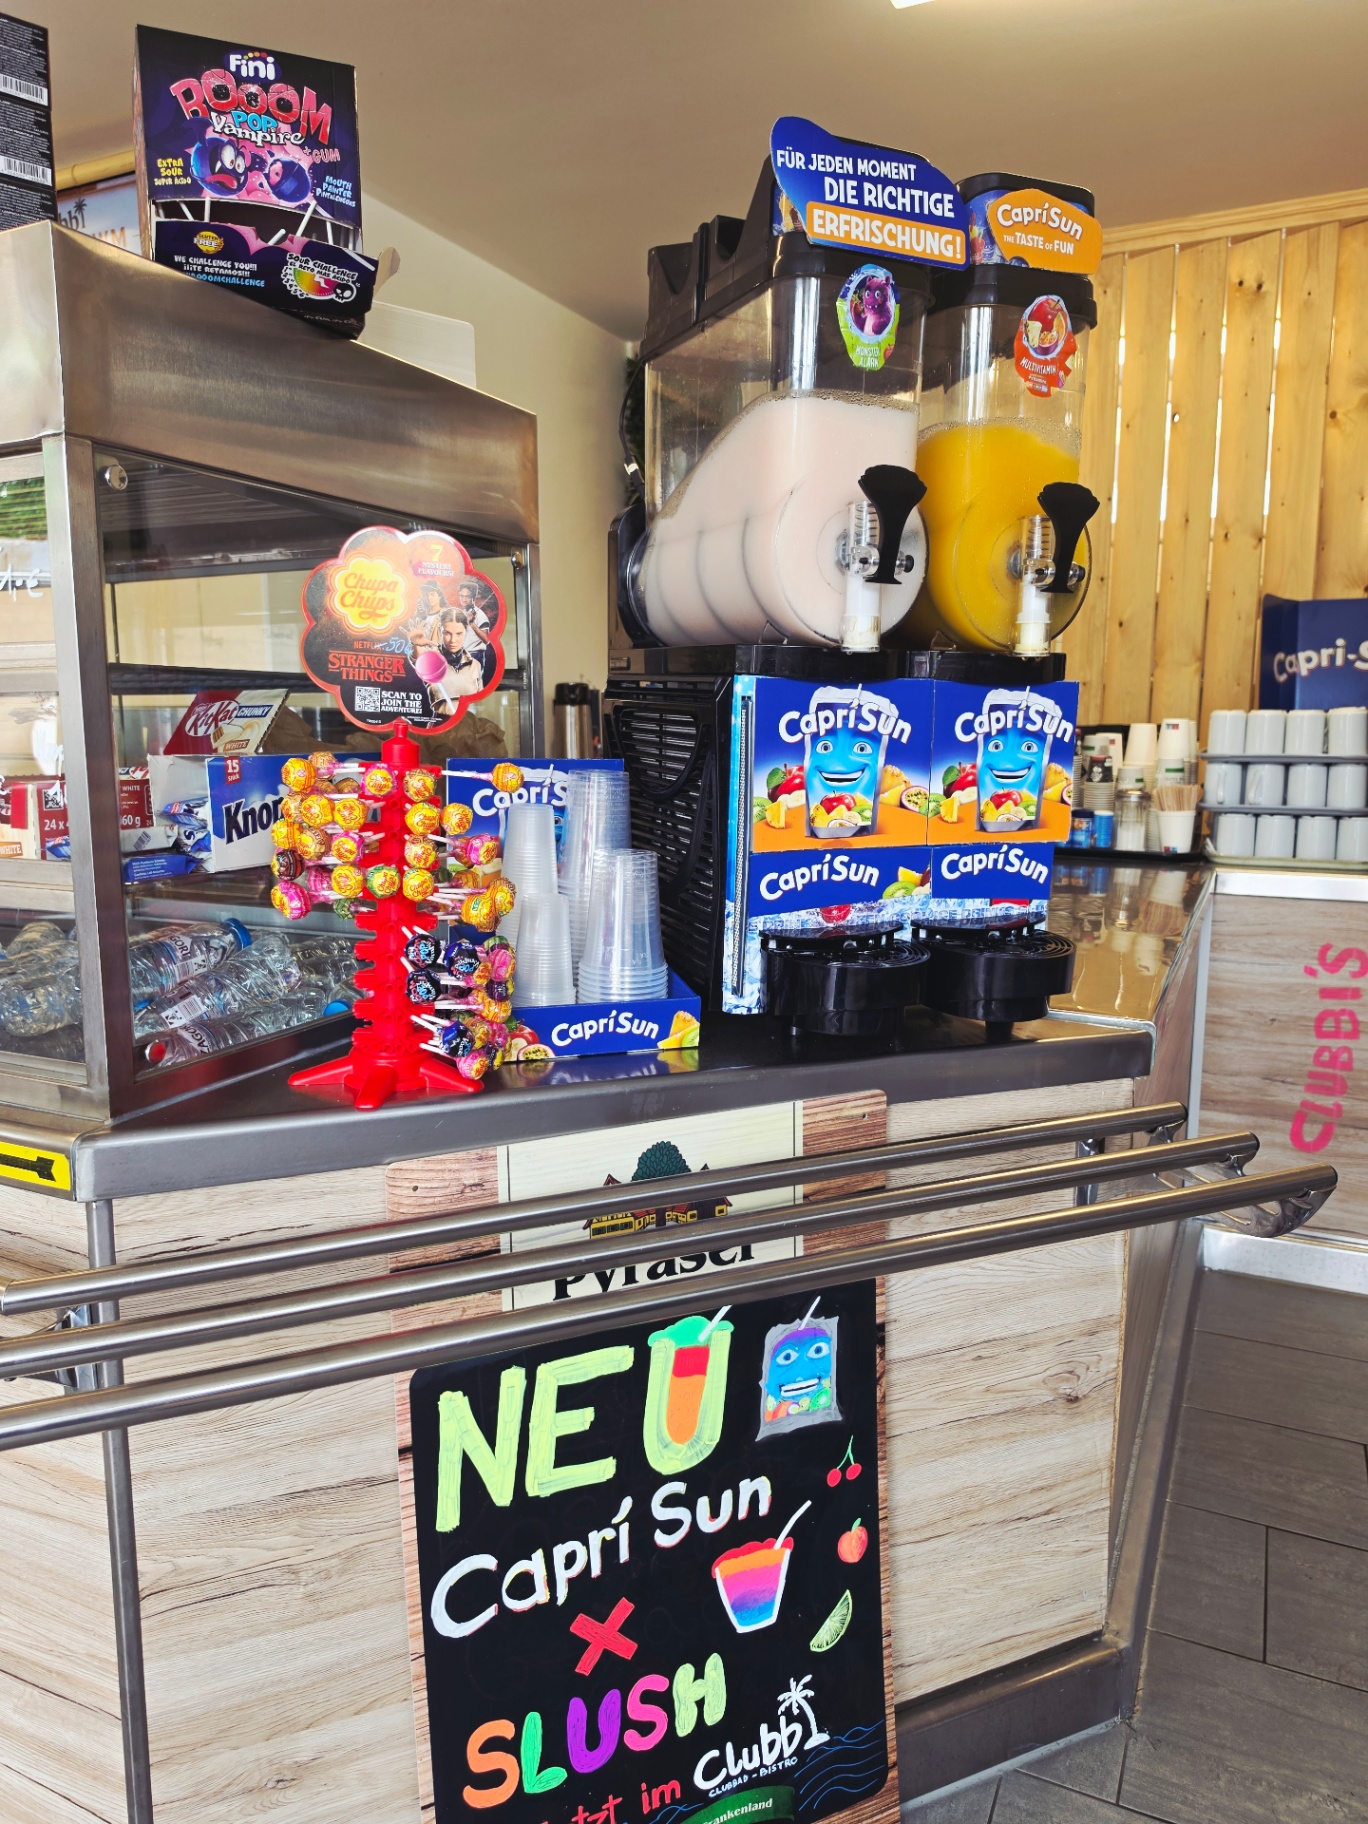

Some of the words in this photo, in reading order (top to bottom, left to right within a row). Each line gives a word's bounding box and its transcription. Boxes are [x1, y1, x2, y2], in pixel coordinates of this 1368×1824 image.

[229, 54, 276, 80] Fini
[210, 112, 305, 147] Vampire
[231, 111, 278, 131] POP
[157, 158, 184, 168] EXTRA
[160, 167, 183, 177] SOUR
[776, 146, 806, 169] FÜR
[808, 153, 853, 175] JEDEN
[857, 158, 917, 181] MOMENT
[824, 176, 859, 205] DIE
[863, 182, 955, 218] RICHTIGE
[193, 237, 219, 248] FREE
[813, 208, 961, 259] ERFRISCHUNG!
[1003, 234, 1015, 244] THE
[1015, 232, 1044, 249] TASTE
[1053, 239, 1075, 255] FUN
[174, 255, 187, 263] WE
[188, 257, 232, 269] CHALLENGE
[287, 253, 312, 267] SOUR
[312, 261, 358, 281] CHALLENGE
[298, 264, 315, 274] RETO
[431, 544, 443, 562] 7
[343, 572, 398, 594] Chupa
[340, 590, 395, 620] Chups
[328, 652, 406, 674] STRANGER
[340, 667, 393, 683] THINGS
[381, 690, 407, 700] SCAN
[409, 692, 422, 700] TO
[405, 700, 421, 708] THE
[237, 706, 272, 717] CHUNKY
[225, 740, 248, 750] WHITE
[226, 759, 239, 773] 15
[44, 819, 57, 831] 24
[436, 1315, 735, 1534] NEU
[650, 1475, 772, 1548] Sun
[462, 1652, 727, 1809] SLUSH
[708, 1773, 749, 1798] CLUBBAD
[759, 1756, 799, 1778] BISTRO
[640, 1779, 681, 1815] im
[703, 1798, 774, 1824] rankenland
